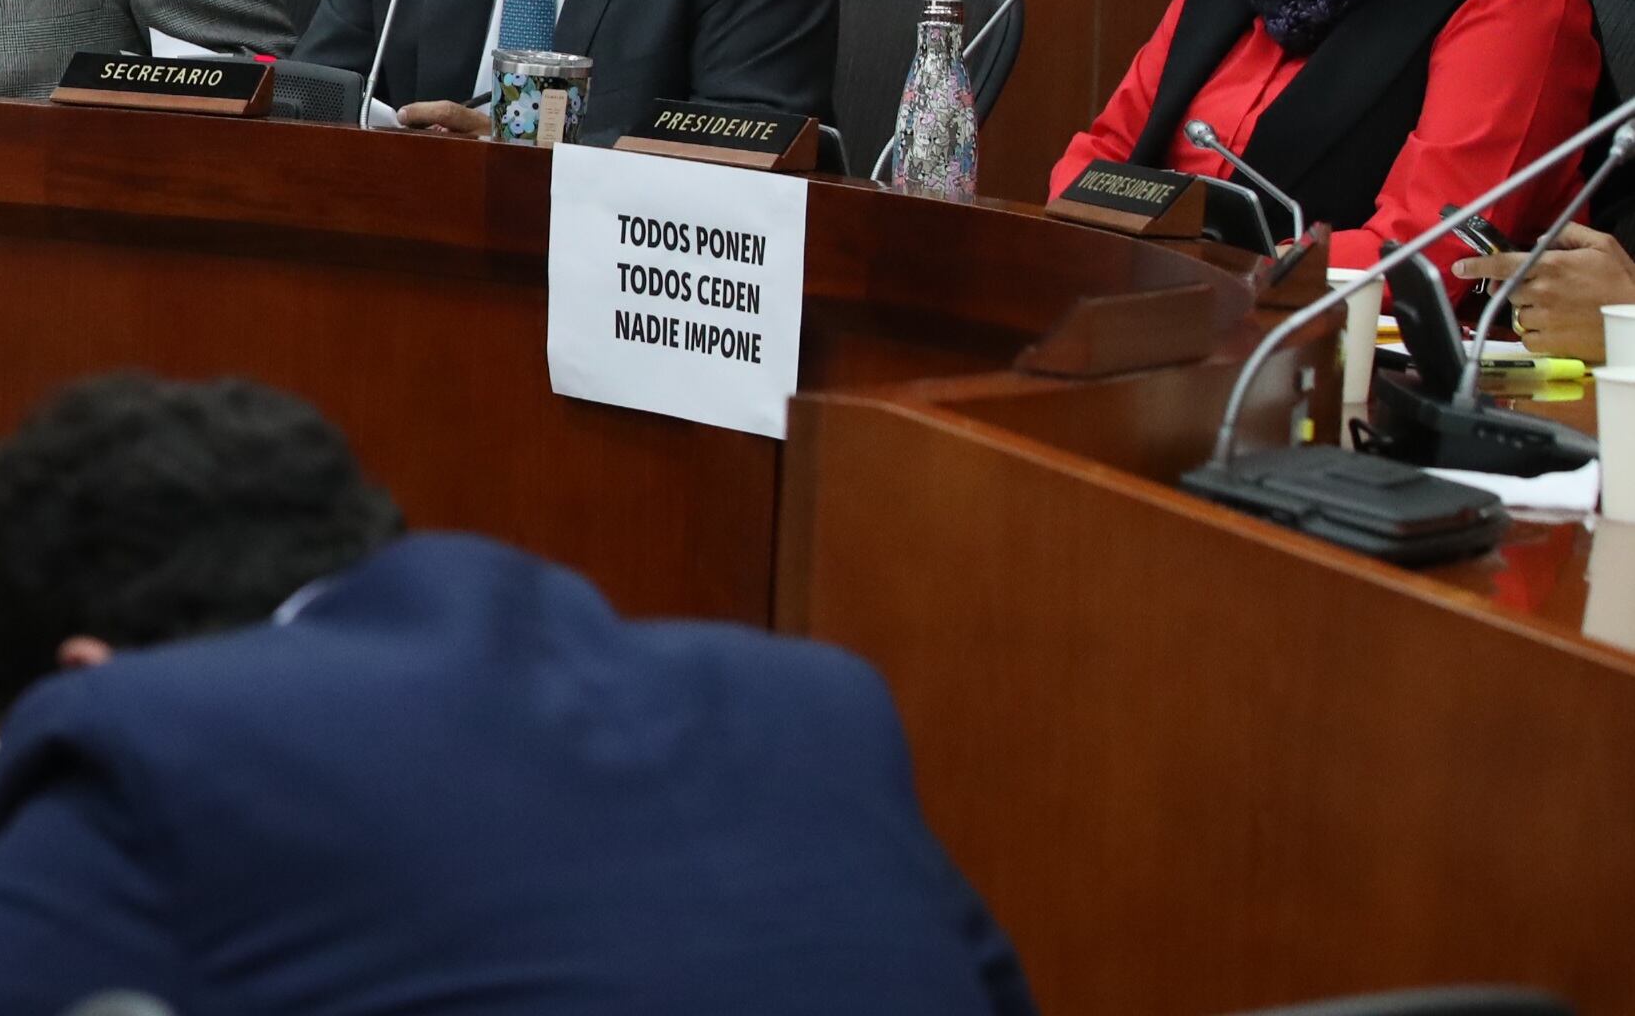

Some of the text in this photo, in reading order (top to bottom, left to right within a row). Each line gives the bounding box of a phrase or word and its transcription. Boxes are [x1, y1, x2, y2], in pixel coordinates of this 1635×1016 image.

[100, 62, 223, 86] SECRETARIO
[654, 111, 778, 140] PRESIDENTE
[1077, 169, 1176, 204] VICEPRESIDENTE
[617, 214, 766, 266] TODOS PONEN
[616, 262, 760, 315] TODOS CEDEN
[615, 309, 762, 364] NADIE IMPONE
